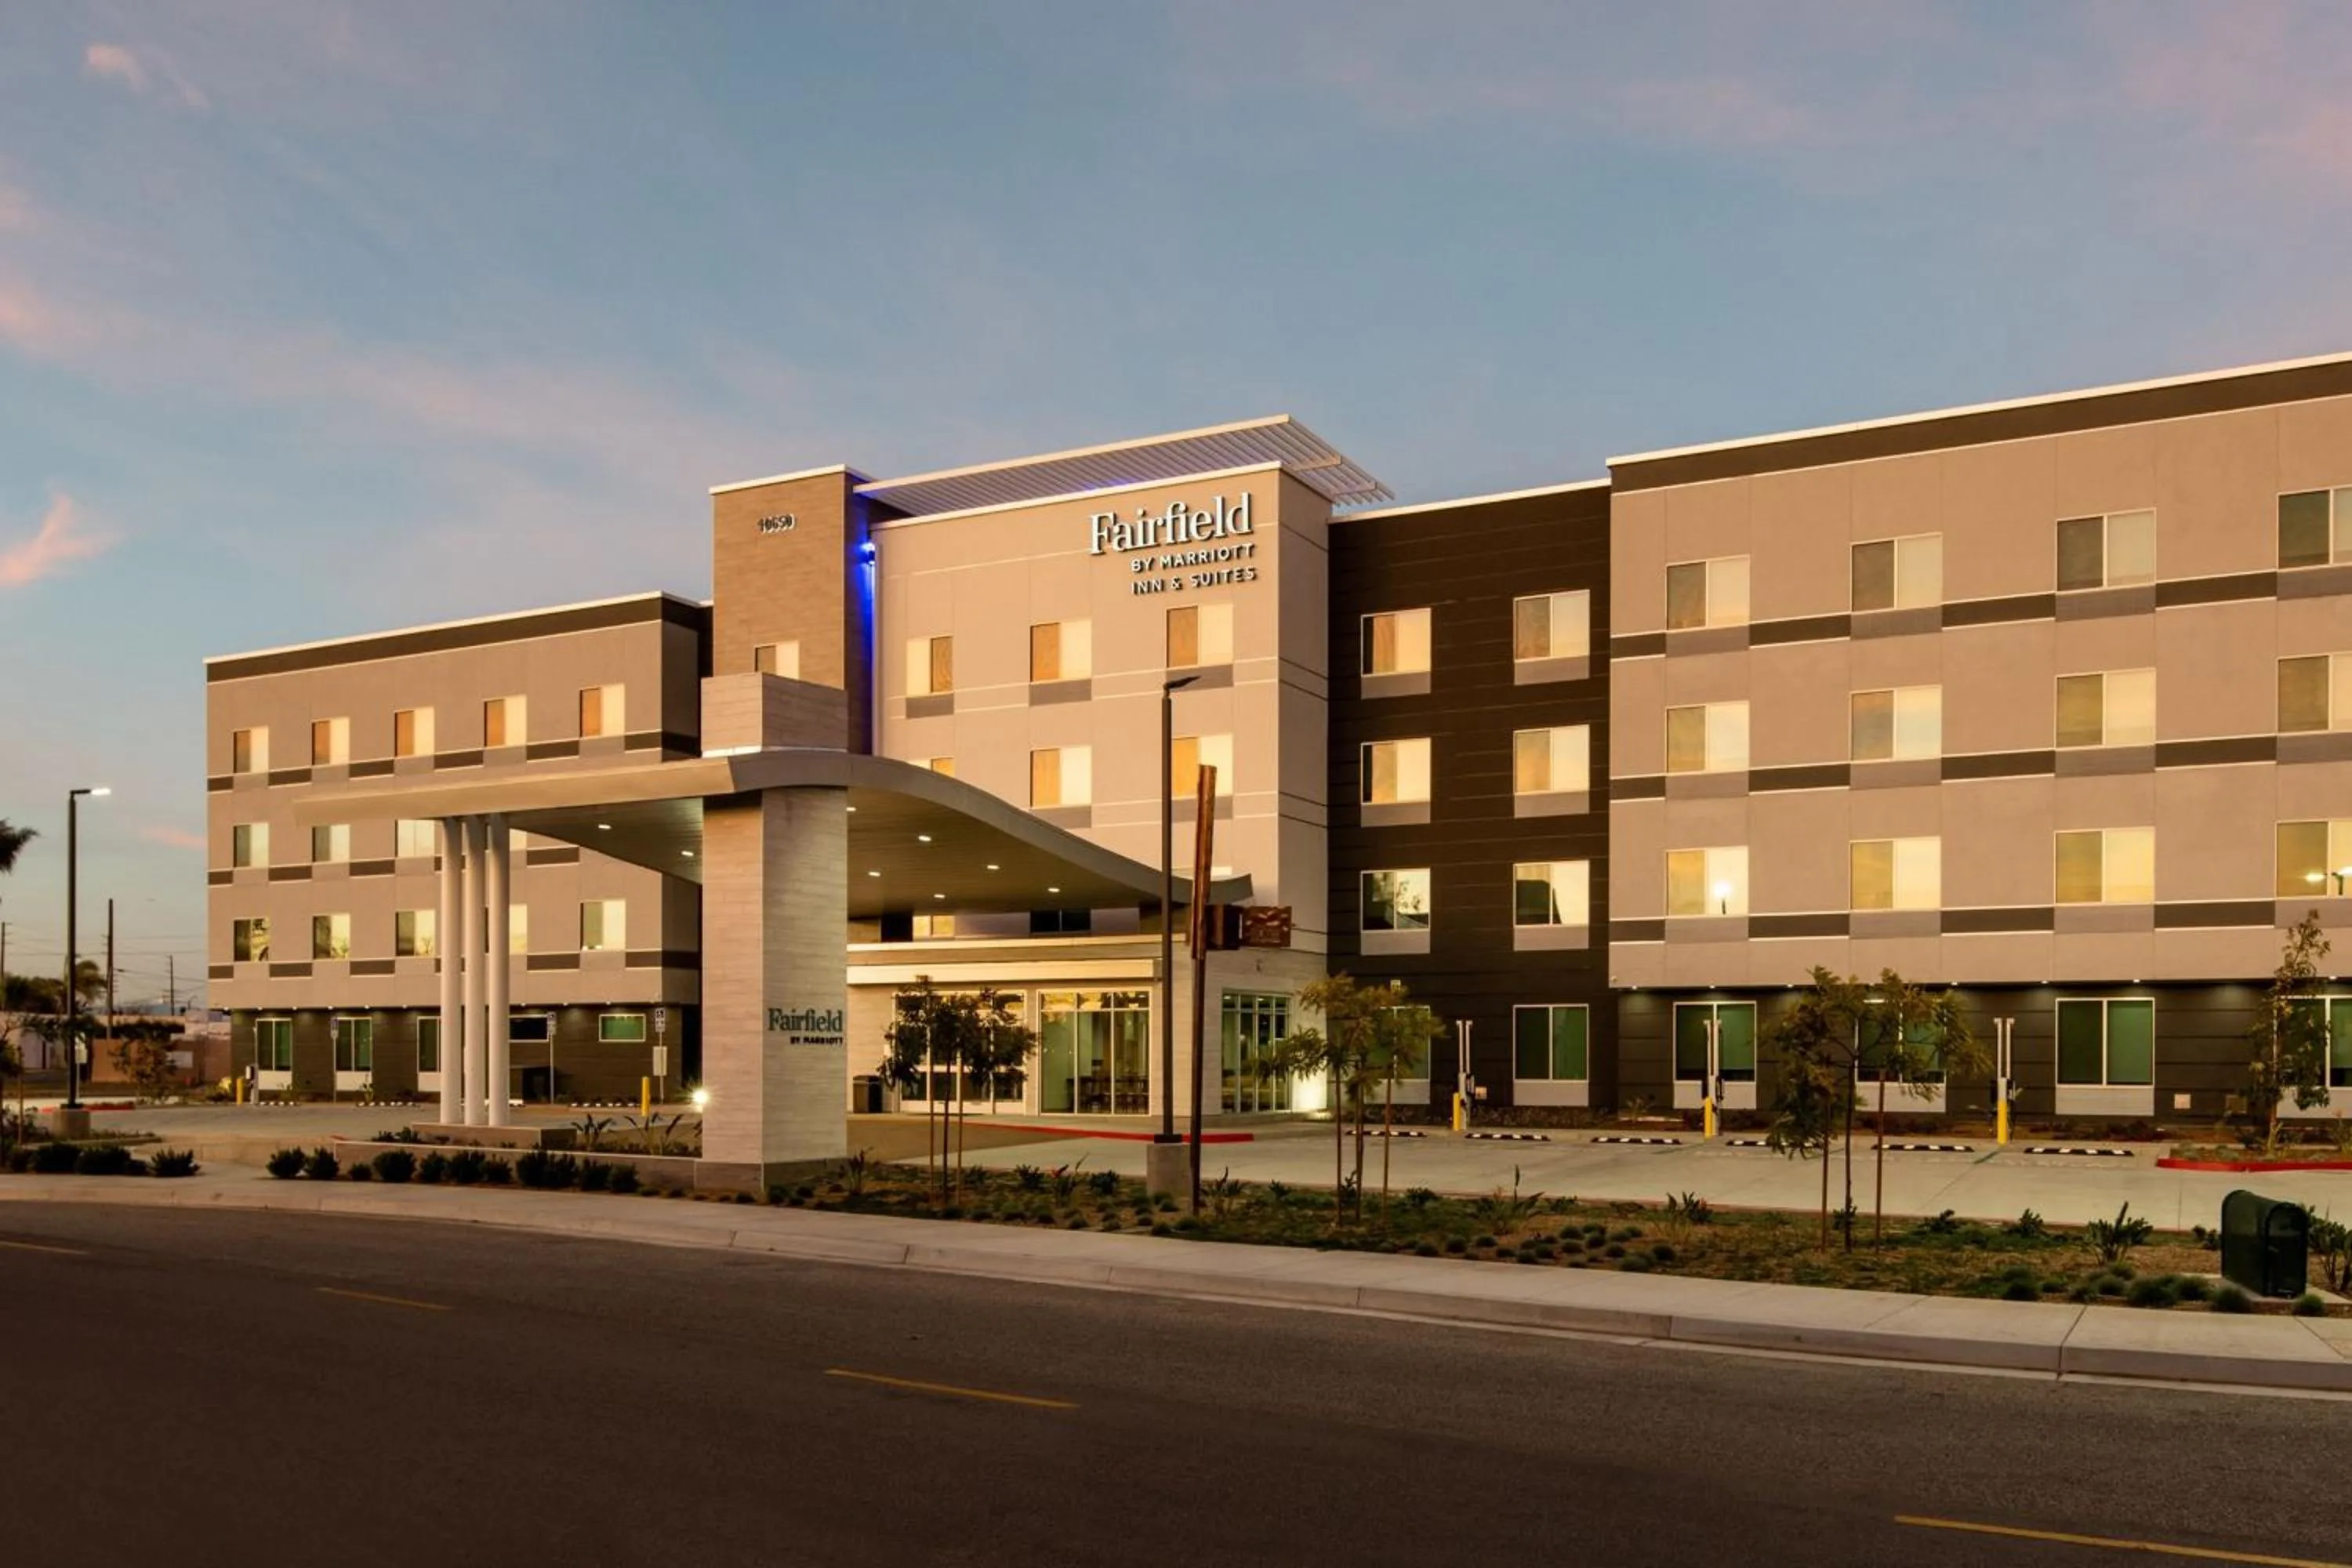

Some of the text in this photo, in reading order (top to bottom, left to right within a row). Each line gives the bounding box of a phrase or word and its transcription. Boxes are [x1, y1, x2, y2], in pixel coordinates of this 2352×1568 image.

[1091, 492, 1254, 555] Fairfield
[1131, 543, 1256, 573] BY MARRIOTT
[1132, 567, 1258, 595] INN & SUITES
[768, 1007, 843, 1032] Fairfield
[790, 1036, 844, 1045] BY MARRIOTT
